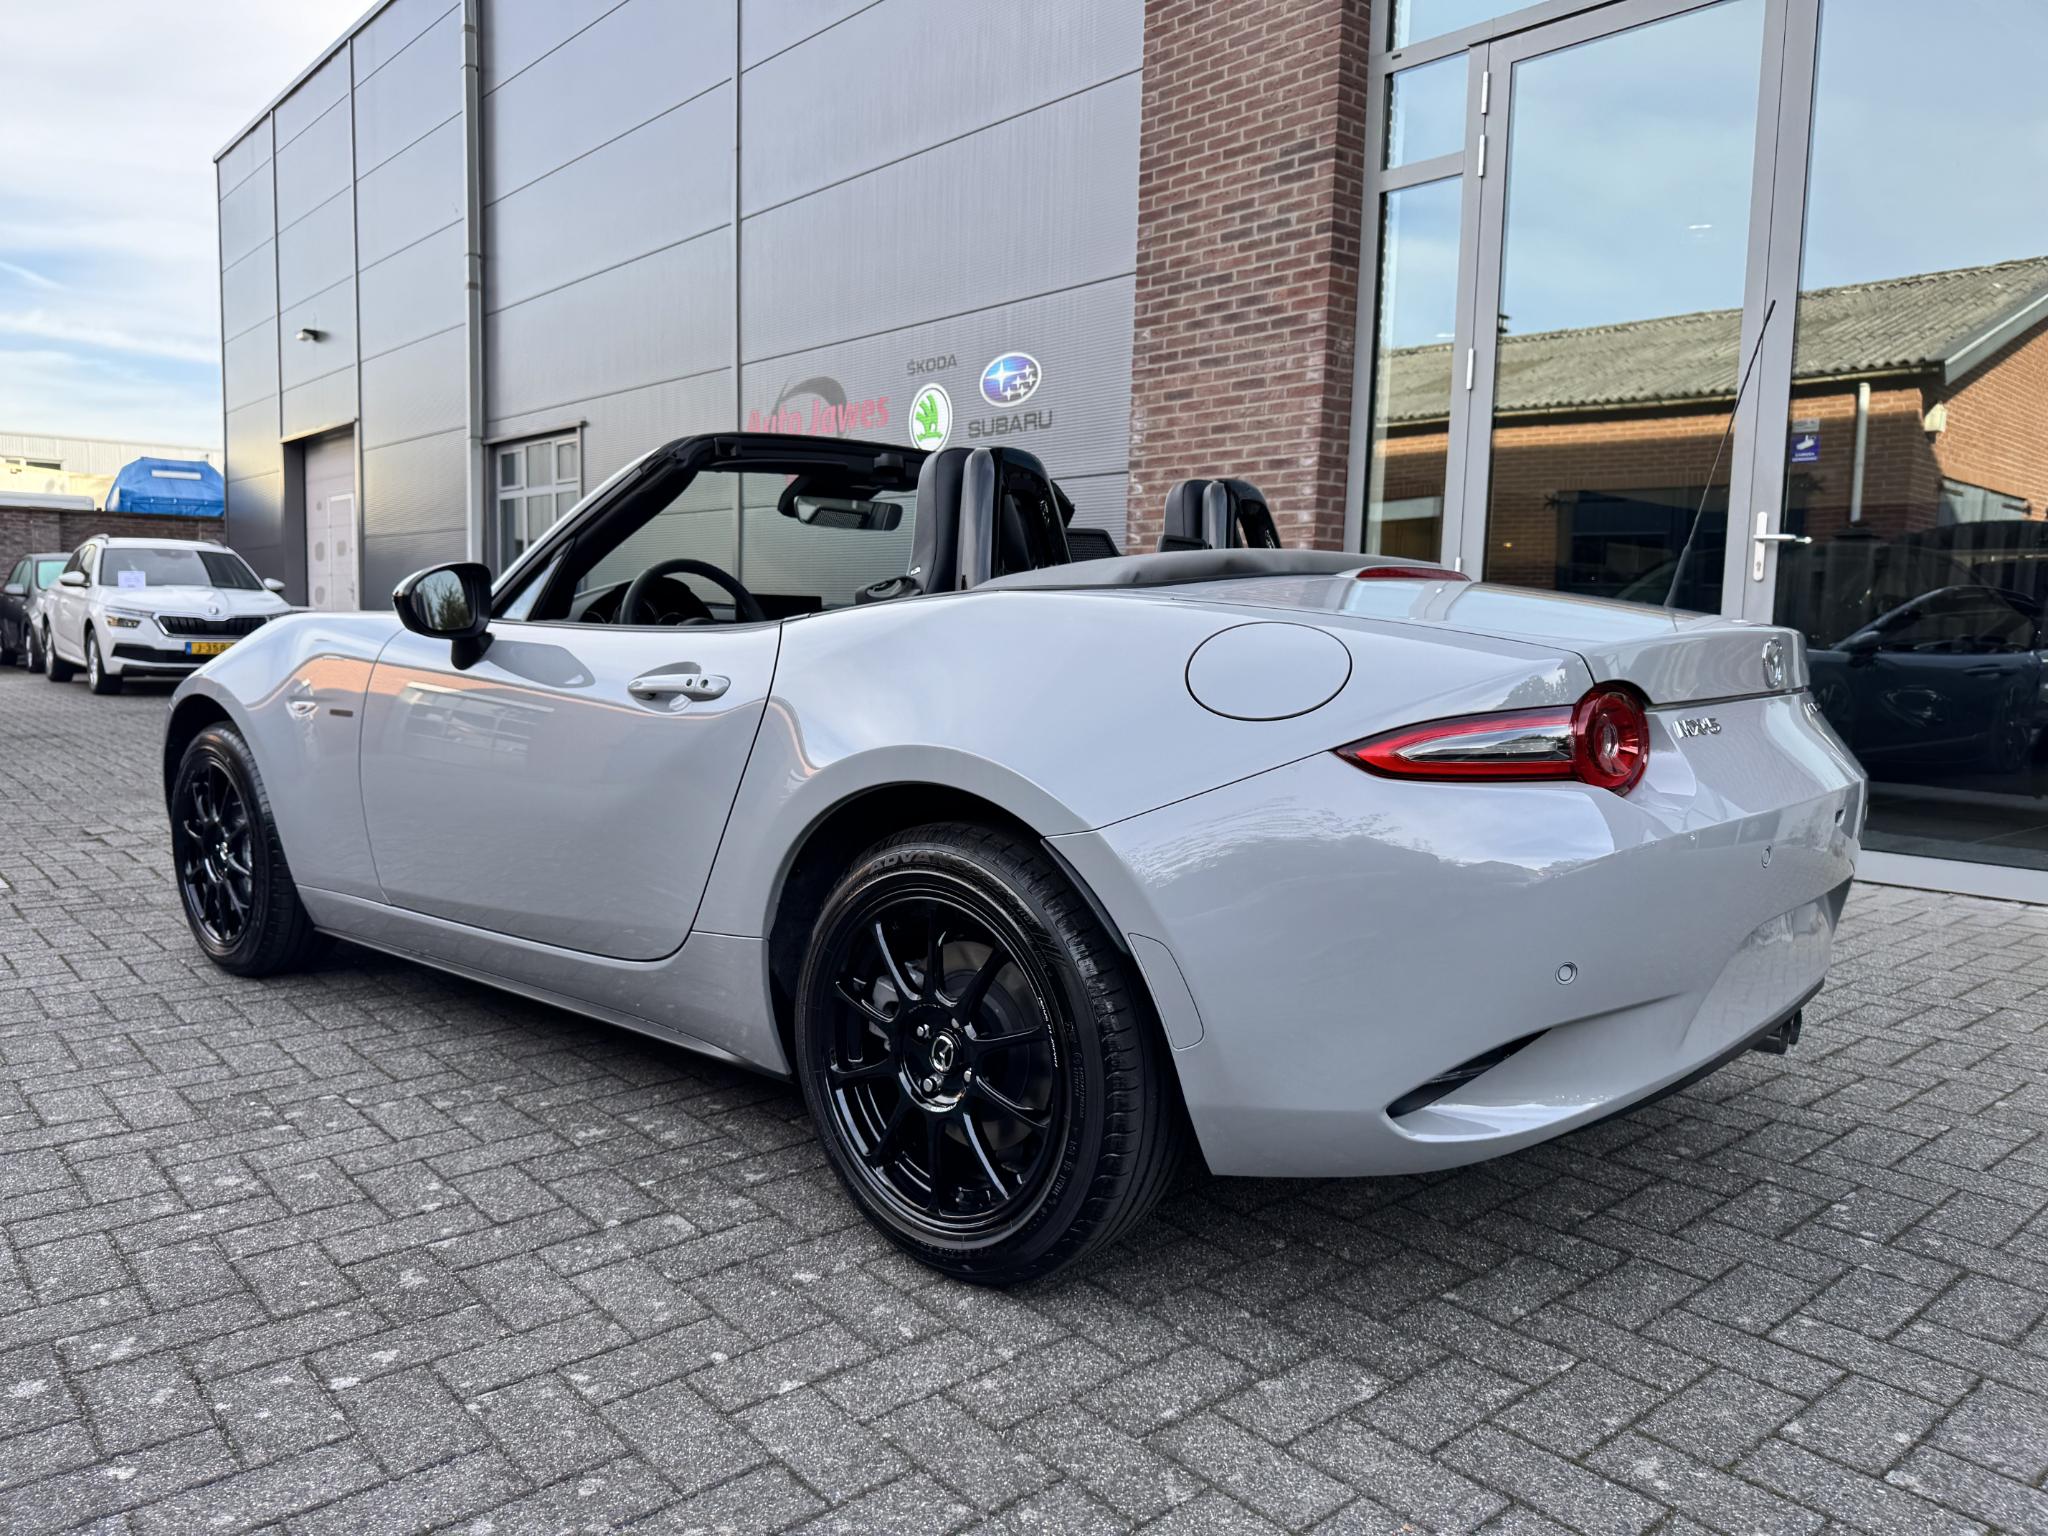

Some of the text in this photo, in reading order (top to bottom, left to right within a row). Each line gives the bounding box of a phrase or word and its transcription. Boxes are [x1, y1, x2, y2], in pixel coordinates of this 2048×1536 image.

[906, 354, 957, 375] ŠKODA
[747, 402, 802, 434] Auto
[968, 410, 1052, 438] SUBARU
[868, 851, 943, 875] ADVA
